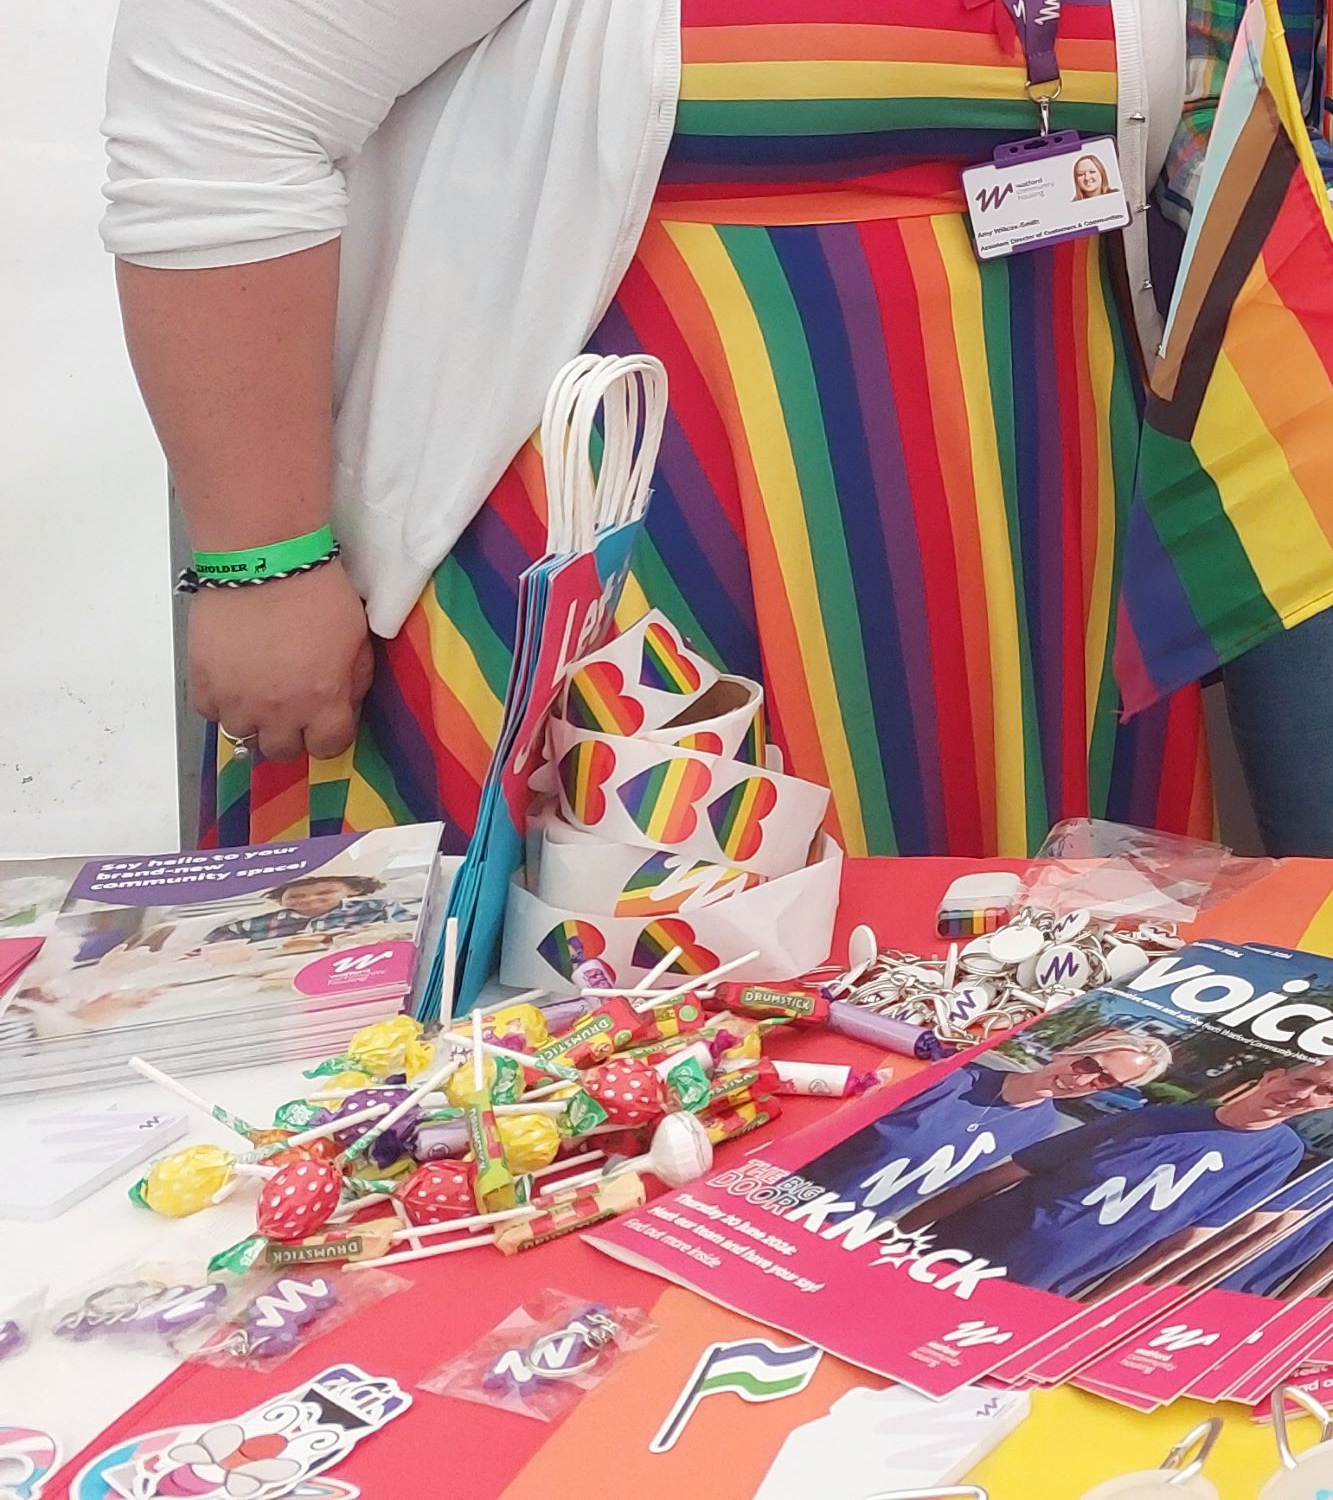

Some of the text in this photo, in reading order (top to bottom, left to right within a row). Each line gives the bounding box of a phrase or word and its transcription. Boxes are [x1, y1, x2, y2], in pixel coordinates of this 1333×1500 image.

[100, 845, 300, 872] Say hello to your
[90, 860, 308, 891] community space!
[96, 862, 224, 881] brand-new
[744, 990, 812, 1011] DRUMSTICK
[542, 1015, 612, 1061] DRUMSTICK
[738, 1159, 792, 1184] THE
[704, 1169, 800, 1216] DOOR
[271, 1243, 359, 1263] DRUMSTICK
[1297, 1380, 1319, 1392] nd
